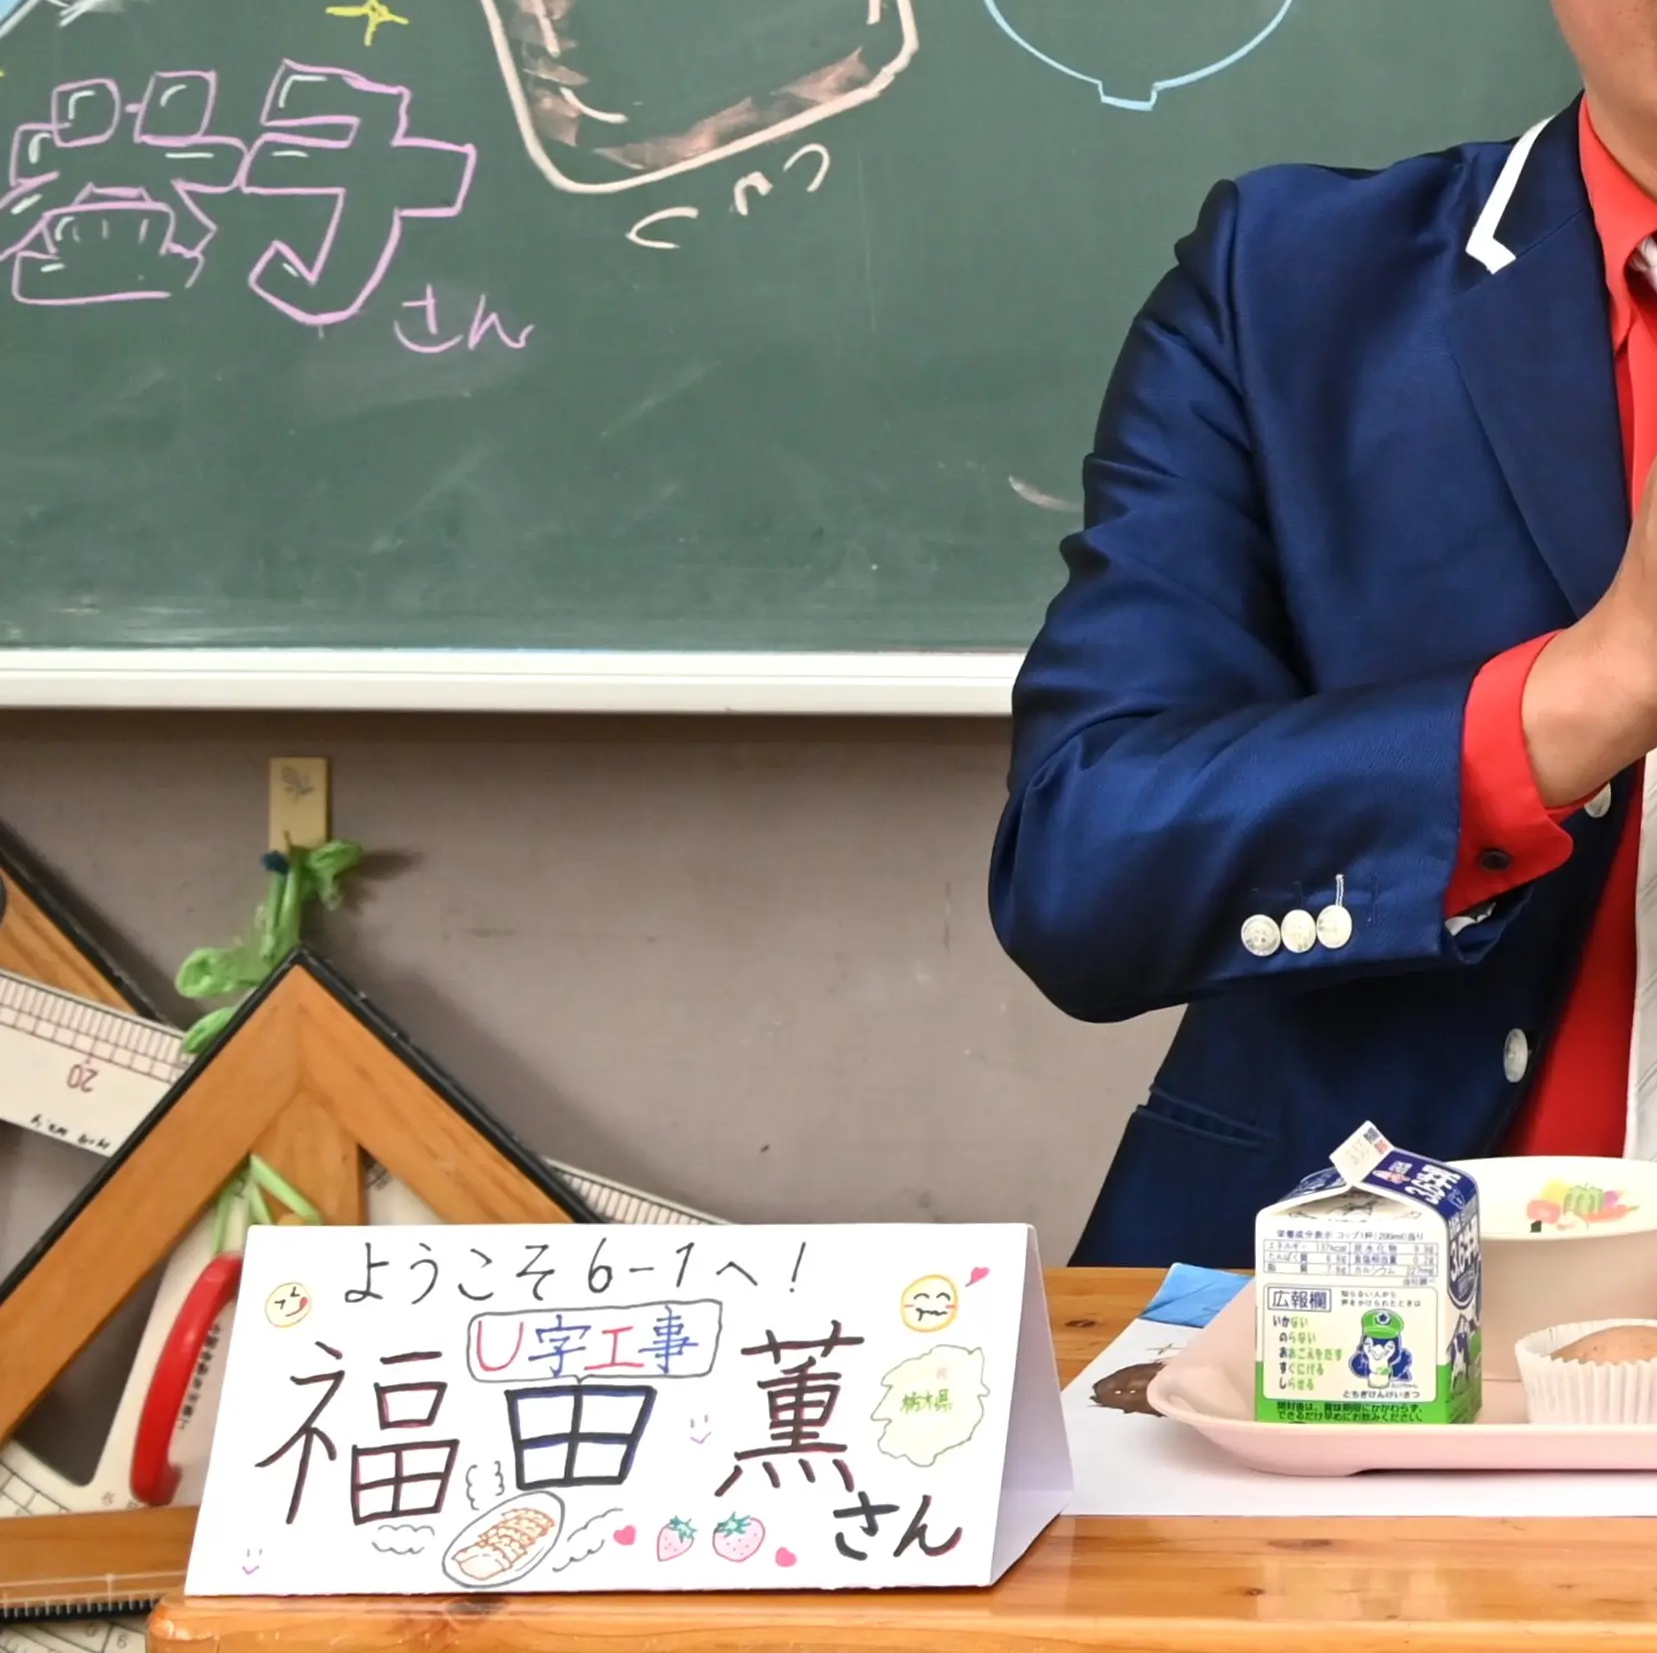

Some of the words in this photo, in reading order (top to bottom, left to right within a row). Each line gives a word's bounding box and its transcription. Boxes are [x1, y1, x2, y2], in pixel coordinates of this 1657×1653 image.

[1271, 1289, 1328, 1310] 広報欄
[475, 1305, 700, 1375] U字工事
